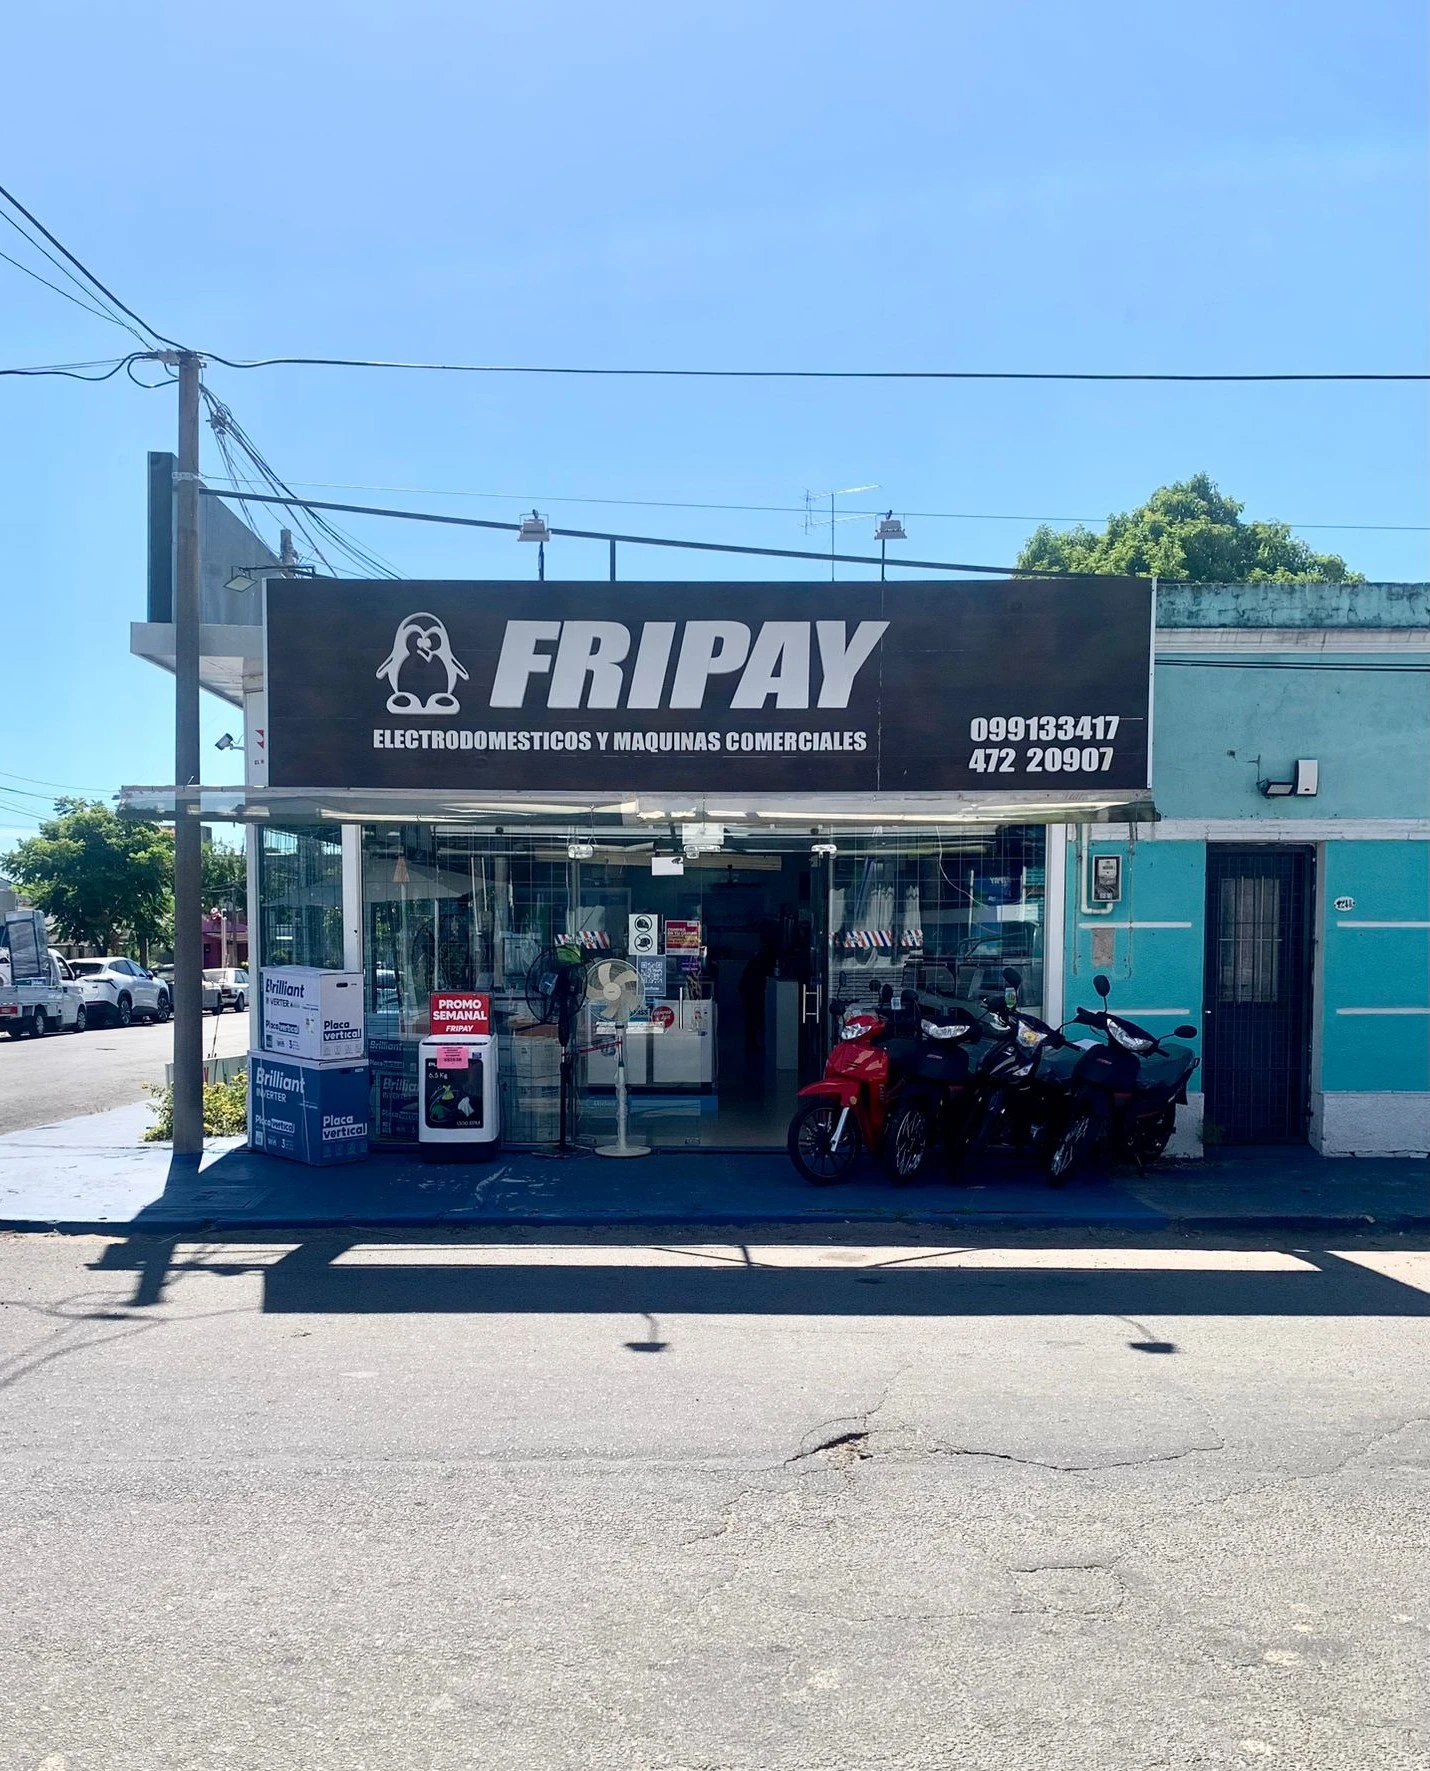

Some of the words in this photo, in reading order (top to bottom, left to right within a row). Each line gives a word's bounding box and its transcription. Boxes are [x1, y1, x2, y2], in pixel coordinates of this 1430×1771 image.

[489, 619, 890, 710] FRIPAY
[970, 715, 1119, 741] 099133417
[373, 729, 592, 751] ELECTRODOMESTICOS
[595, 731, 609, 751] Y
[613, 731, 720, 753] MAQUINAS
[725, 730, 867, 752] COMERCIALES
[969, 748, 1015, 773] 472
[1026, 746, 1114, 772] 20907
[265, 978, 305, 998] Brilliant
[438, 999, 482, 1009] PROMO
[324, 1020, 350, 1030] Placa
[433, 1010, 487, 1021] SEMANAL
[324, 1028, 361, 1040] vertical
[256, 1067, 306, 1094] Brilliant
[323, 1114, 353, 1127] Placa
[323, 1122, 367, 1140] vertical
